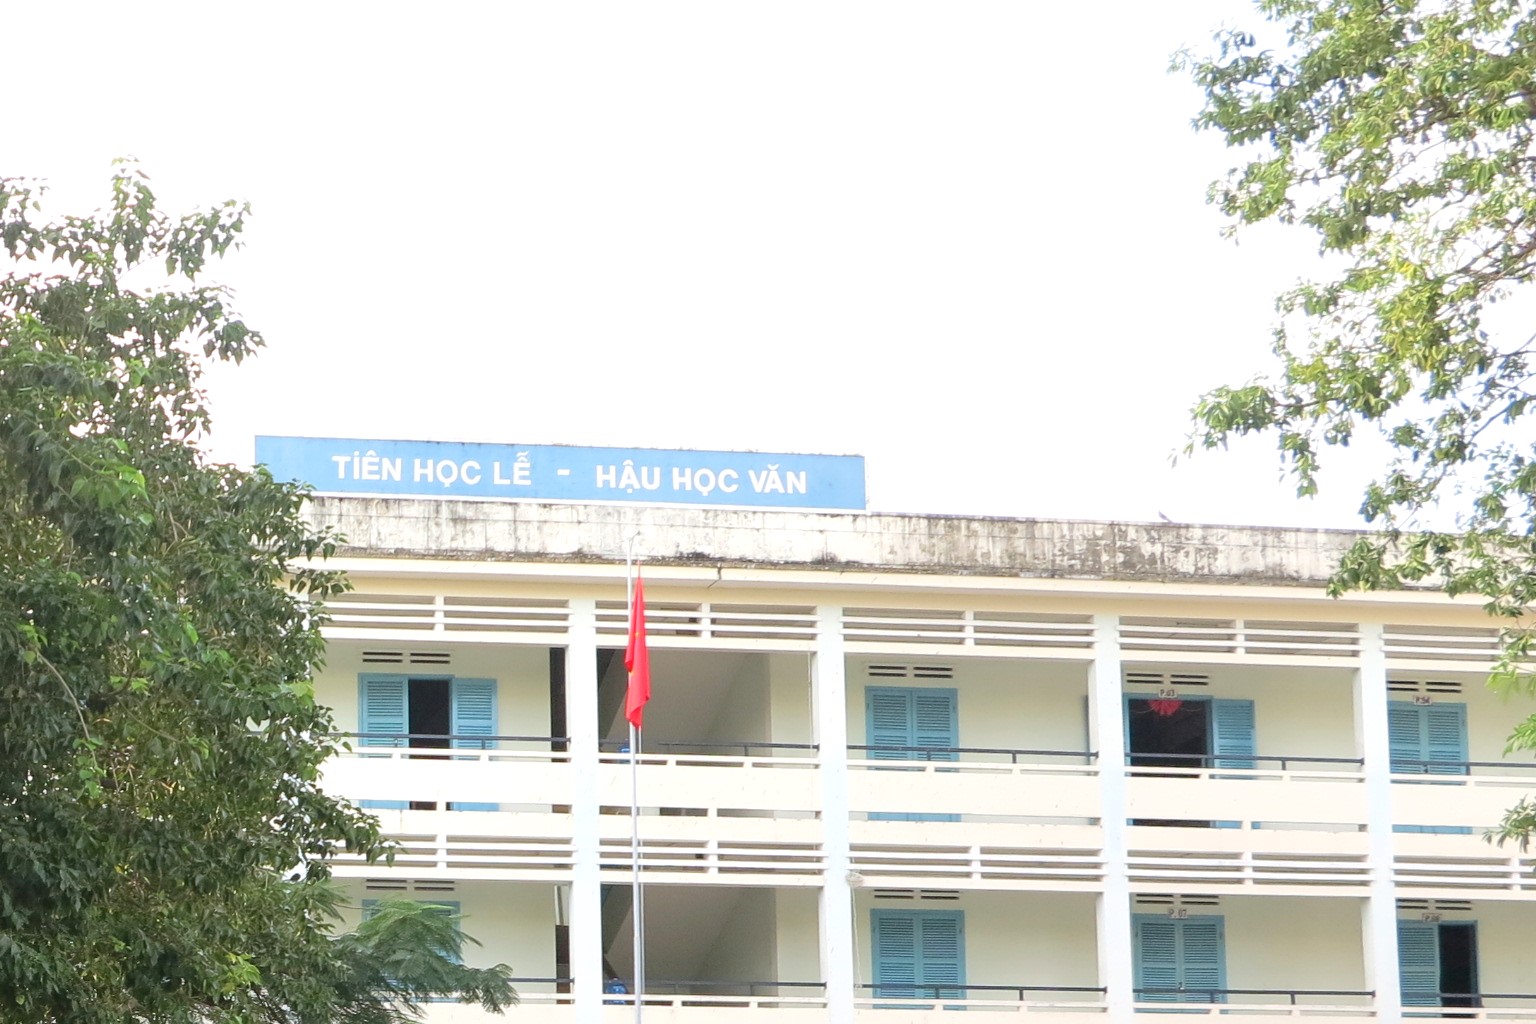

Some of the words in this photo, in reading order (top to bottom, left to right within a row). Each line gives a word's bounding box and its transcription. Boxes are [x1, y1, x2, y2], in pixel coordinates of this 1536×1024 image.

[413, 458, 482, 488] HỌC
[493, 450, 532, 486] LỄ
[596, 459, 661, 494] HẬU
[672, 466, 740, 497] HỌC
[748, 463, 807, 494] VĂN
